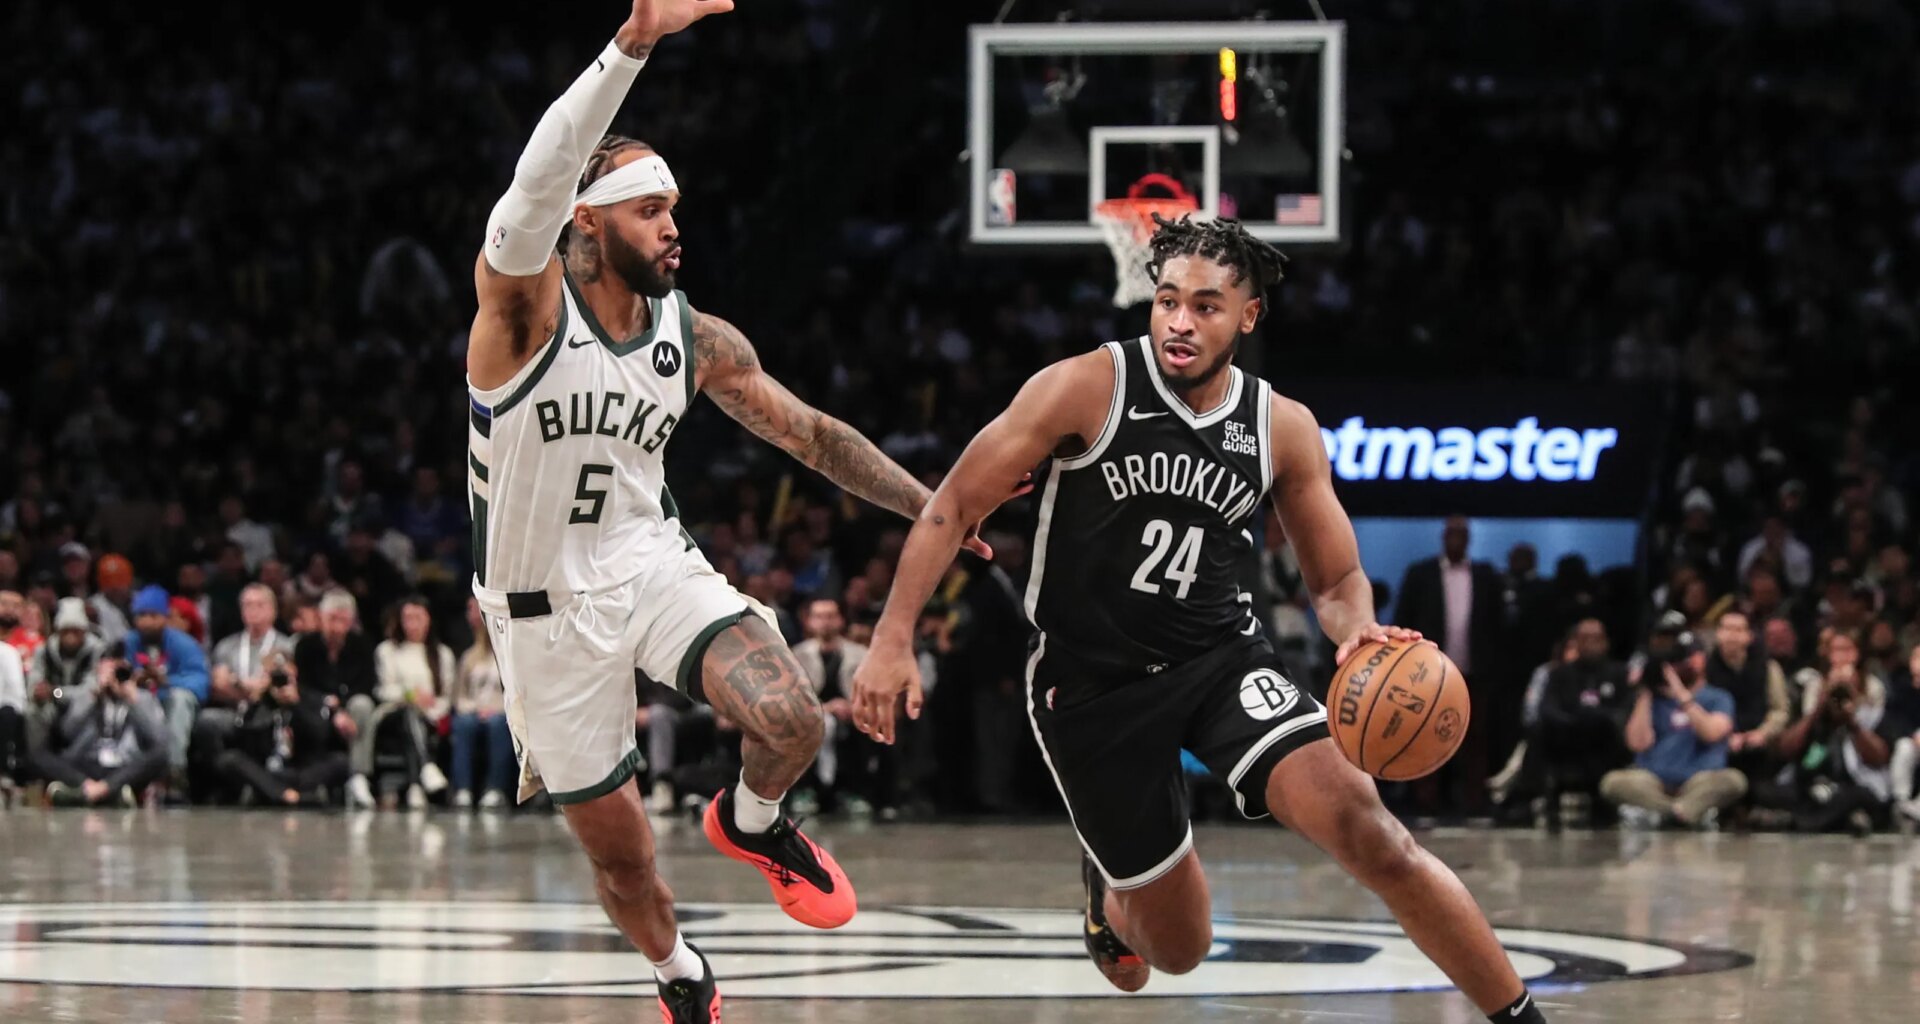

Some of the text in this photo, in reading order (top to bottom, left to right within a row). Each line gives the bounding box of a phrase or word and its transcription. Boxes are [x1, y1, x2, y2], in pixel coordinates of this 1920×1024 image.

[536, 391, 677, 454] BUCKS
[1222, 440, 1258, 456] GUIDE
[1225, 420, 1246, 433] GET
[1225, 430, 1256, 446] YOUR
[568, 463, 613, 525] 5
[1101, 451, 1256, 526] BROOKLYN
[1130, 519, 1205, 600] 24
[1253, 675, 1286, 711] B
[1338, 645, 1399, 727] Wilson
